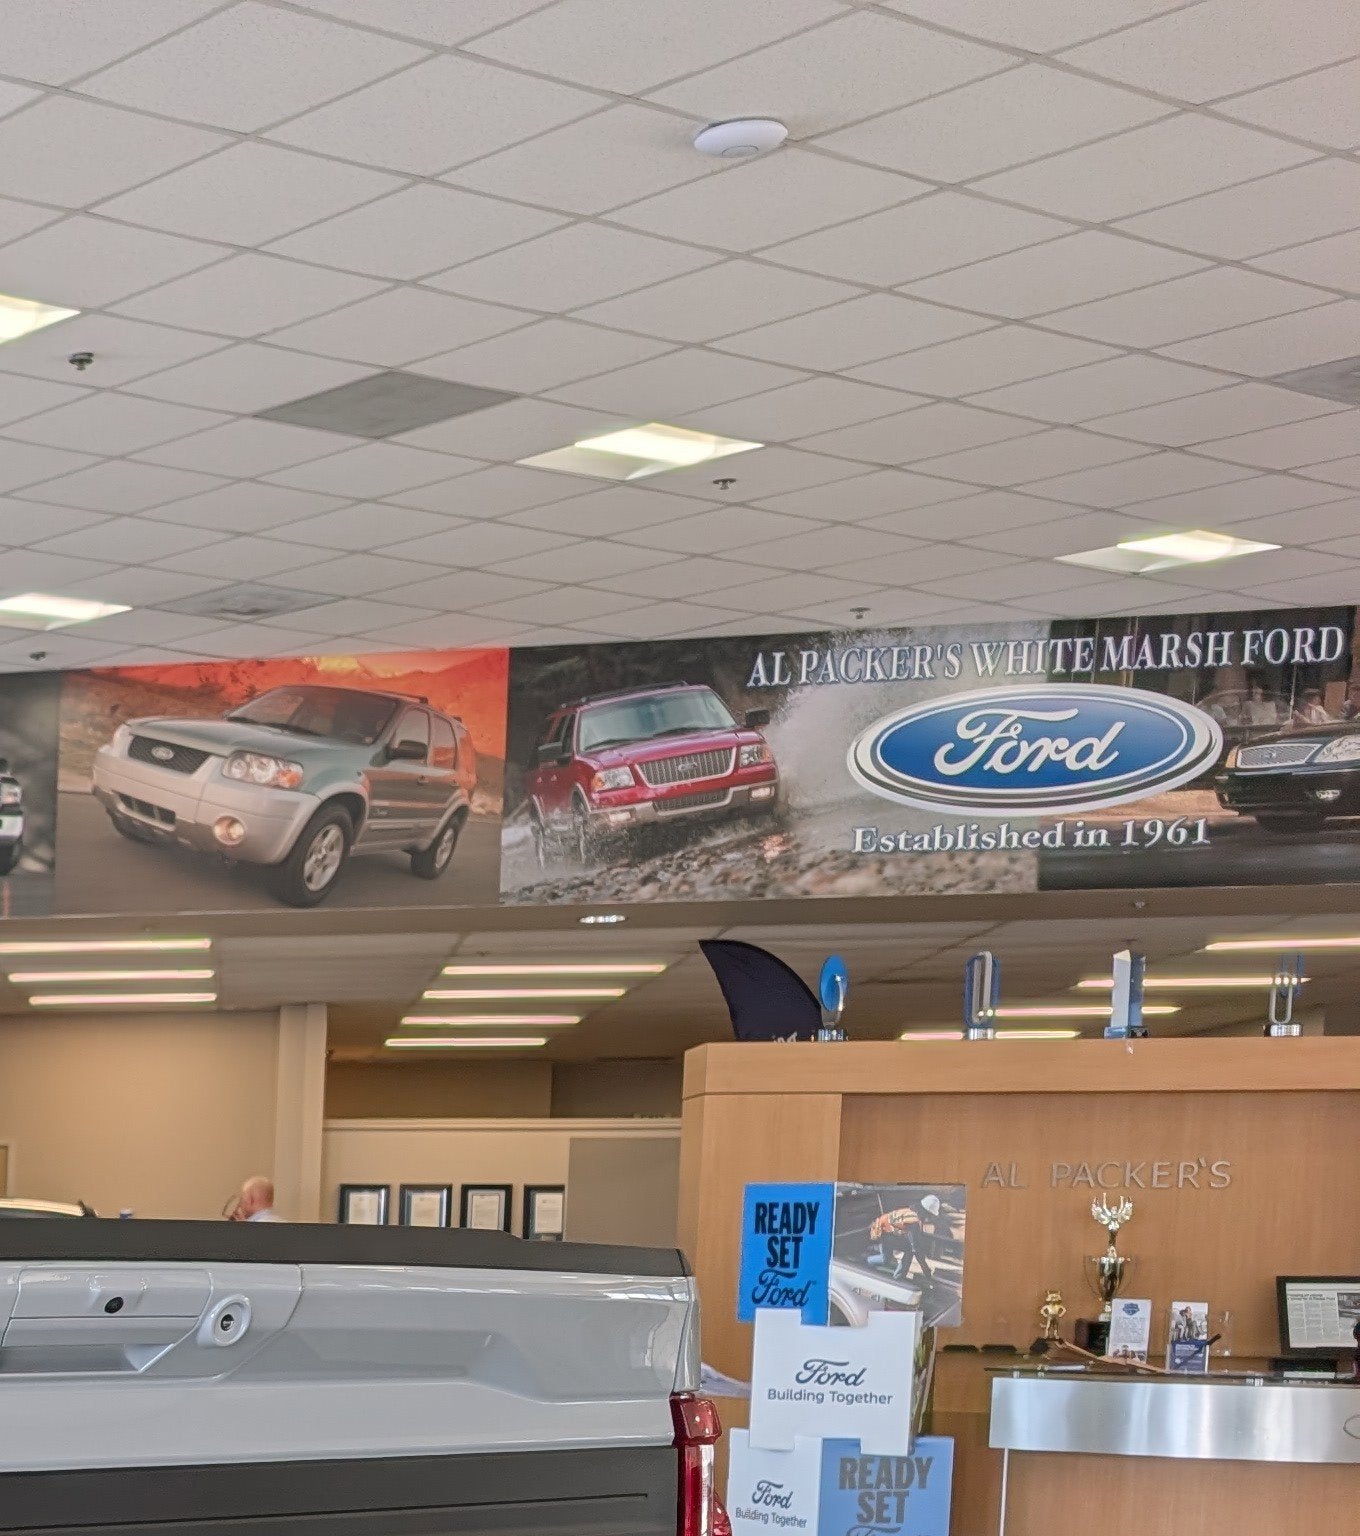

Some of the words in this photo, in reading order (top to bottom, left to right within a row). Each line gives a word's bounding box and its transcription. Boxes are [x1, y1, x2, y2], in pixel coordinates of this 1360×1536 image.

[746, 650, 791, 688] AL
[798, 641, 962, 686] PACKER'S
[968, 636, 1096, 678] WHITE
[1101, 631, 1234, 672] MARSH
[1240, 625, 1345, 666] FORD
[935, 707, 1125, 776] Ford
[851, 820, 1065, 855] Established
[1073, 820, 1111, 848] in
[1121, 816, 1212, 848] 1961
[981, 1160, 1028, 1188] AL
[1050, 1157, 1231, 1189] PACKER'S
[755, 1202, 820, 1234] READY
[766, 1236, 803, 1268] SET
[751, 1269, 811, 1306] Ford
[795, 1358, 868, 1386] Ford
[767, 1388, 825, 1405] Building
[829, 1390, 894, 1405] Together
[838, 1456, 934, 1490] READY
[751, 1479, 794, 1510] Ford
[856, 1491, 910, 1524] SET
[735, 1506, 769, 1525] Building
[771, 1511, 808, 1529] Together
